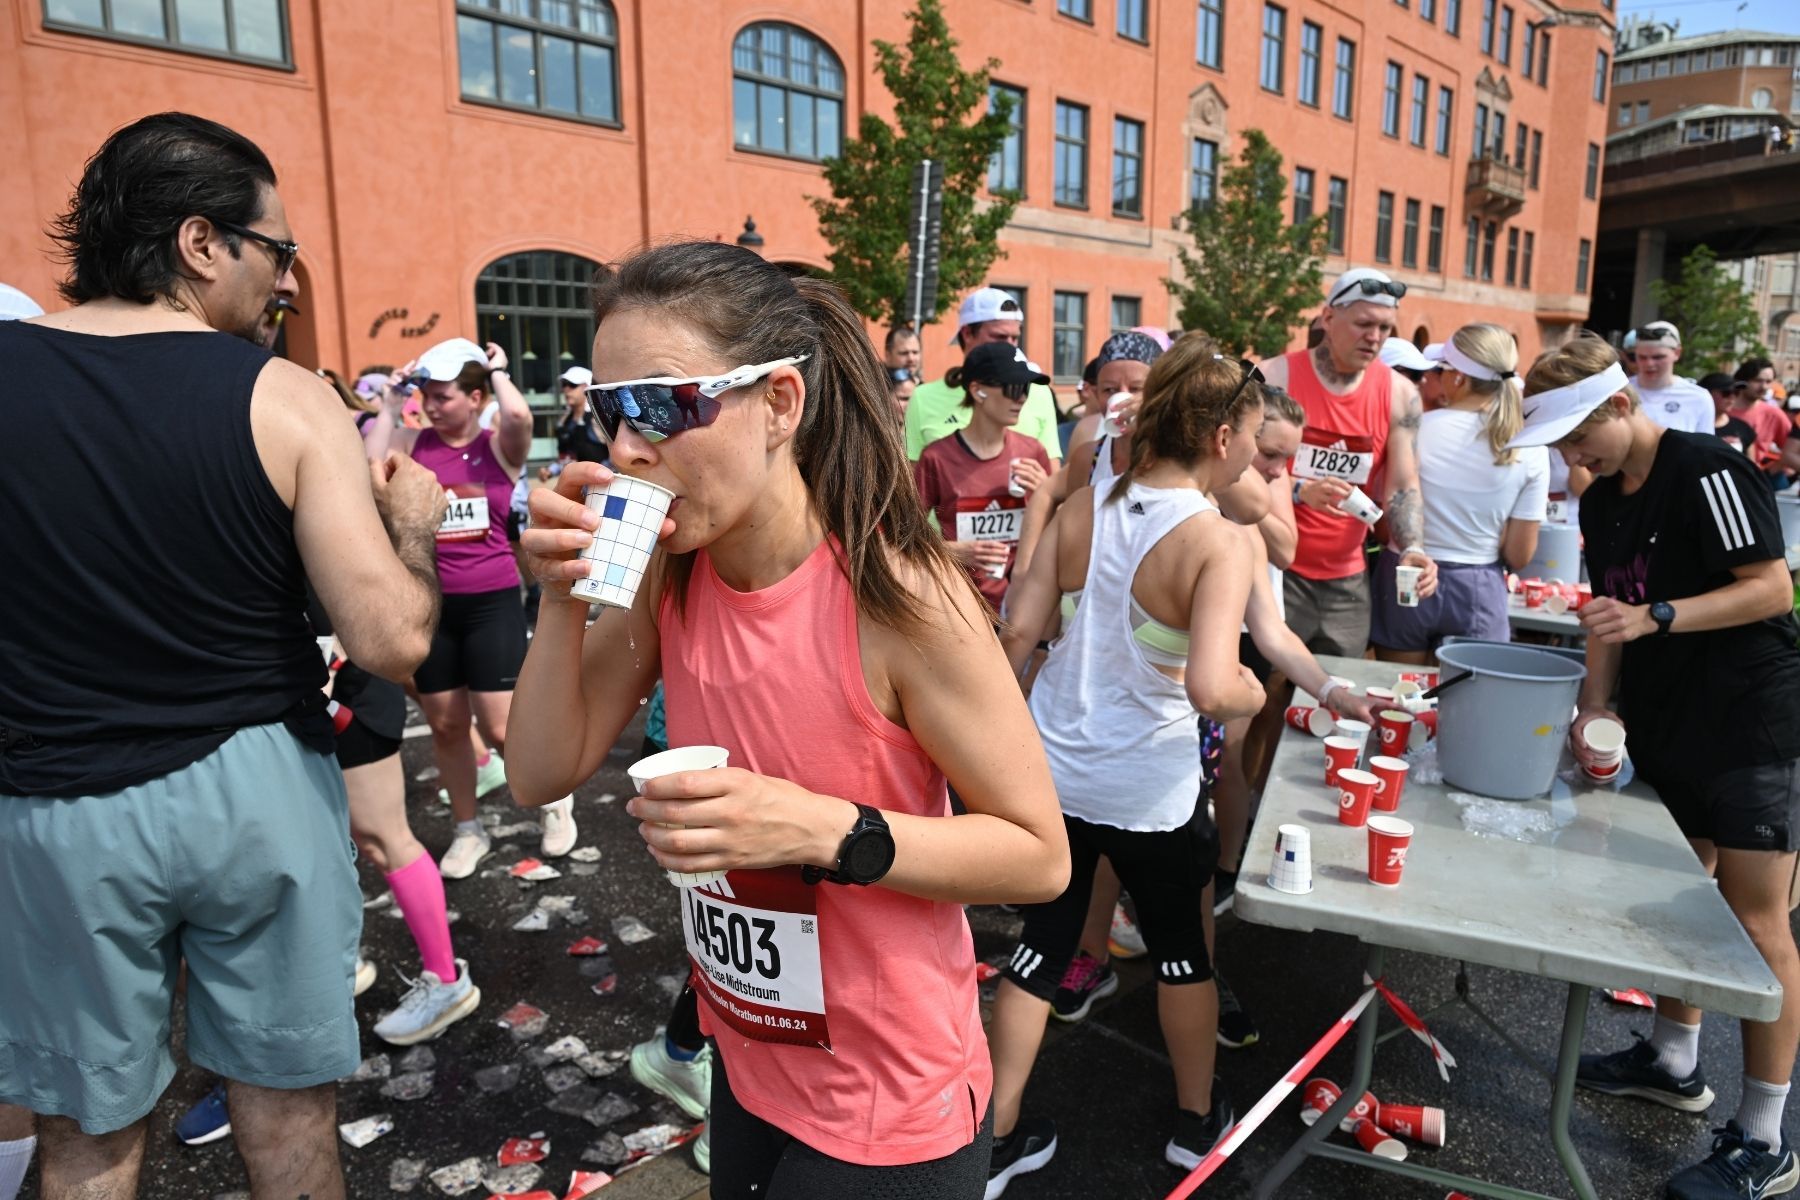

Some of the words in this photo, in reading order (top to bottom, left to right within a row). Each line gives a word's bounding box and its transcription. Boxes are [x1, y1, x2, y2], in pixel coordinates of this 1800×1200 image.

[1310, 448, 1360, 474] 12829
[971, 513, 1014, 535] 12272
[687, 887, 781, 980] 14503
[725, 972, 781, 1002] Midtstraum
[729, 1001, 763, 1025] Marathon
[764, 1014, 808, 1031] 01.06.24
